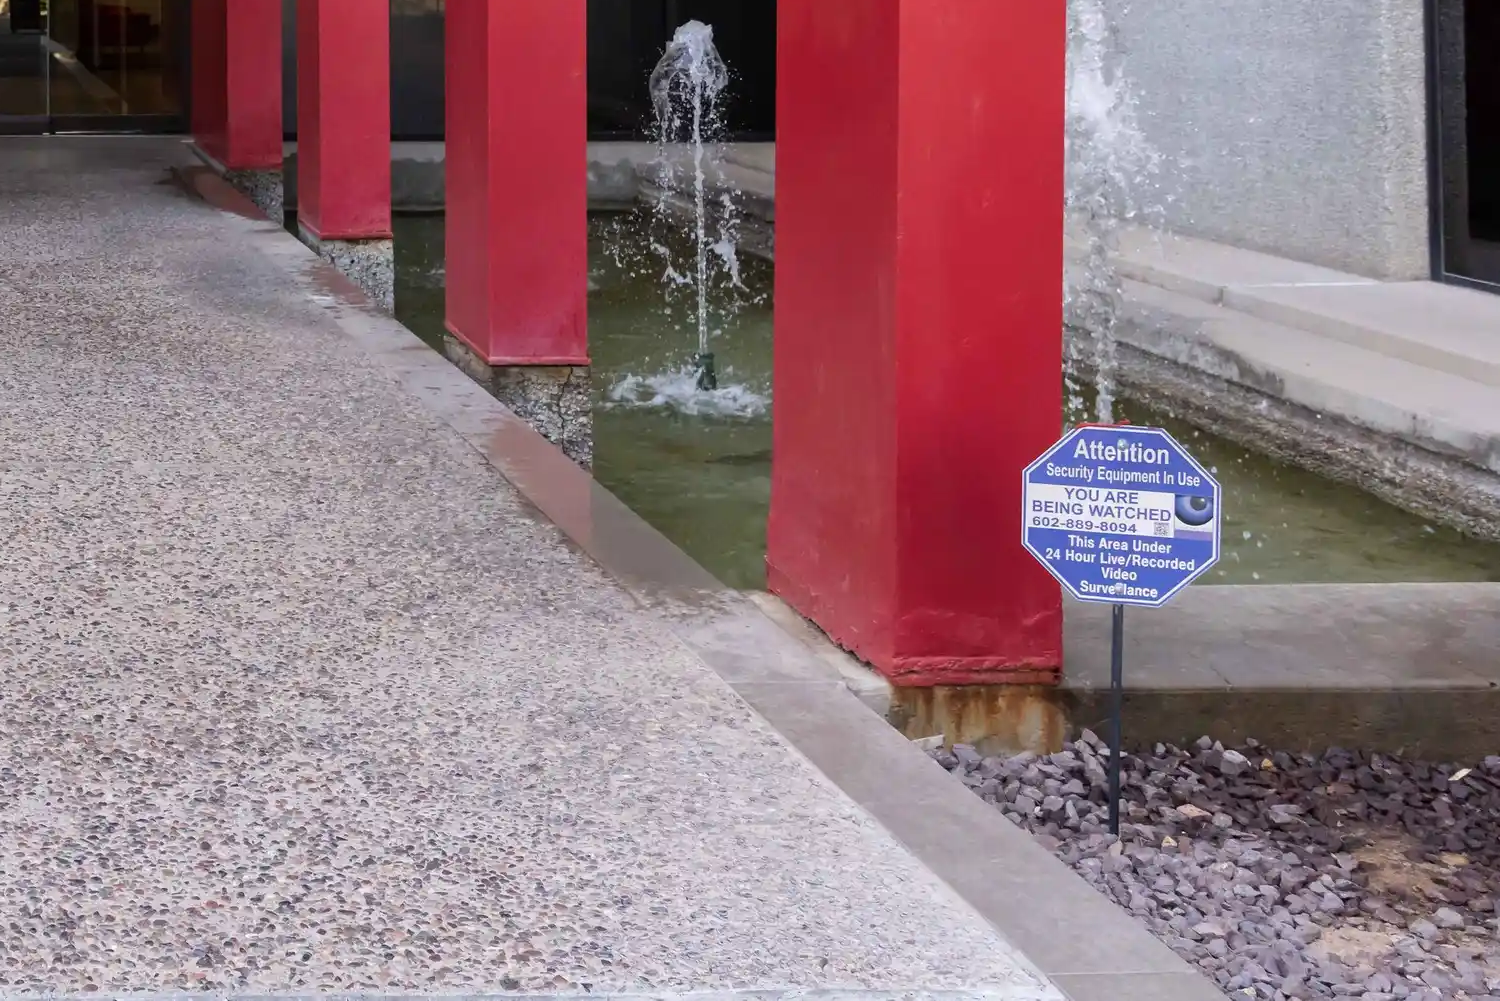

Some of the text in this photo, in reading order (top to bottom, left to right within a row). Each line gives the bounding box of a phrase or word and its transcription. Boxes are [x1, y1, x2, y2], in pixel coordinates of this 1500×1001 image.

[1074, 439, 1169, 465] Attention
[1046, 463, 1200, 487] Security Equipment In Use
[1064, 487, 1138, 504] YOU ARE
[1032, 501, 1171, 522] BEING WATCHED
[1033, 517, 1137, 533] 602-889-8094
[1068, 535, 1172, 554] This Area Under
[1045, 548, 1195, 571] 24 Hour Live/Recorded
[1101, 567, 1137, 581] Video
[1080, 580, 1158, 598] Survelance
